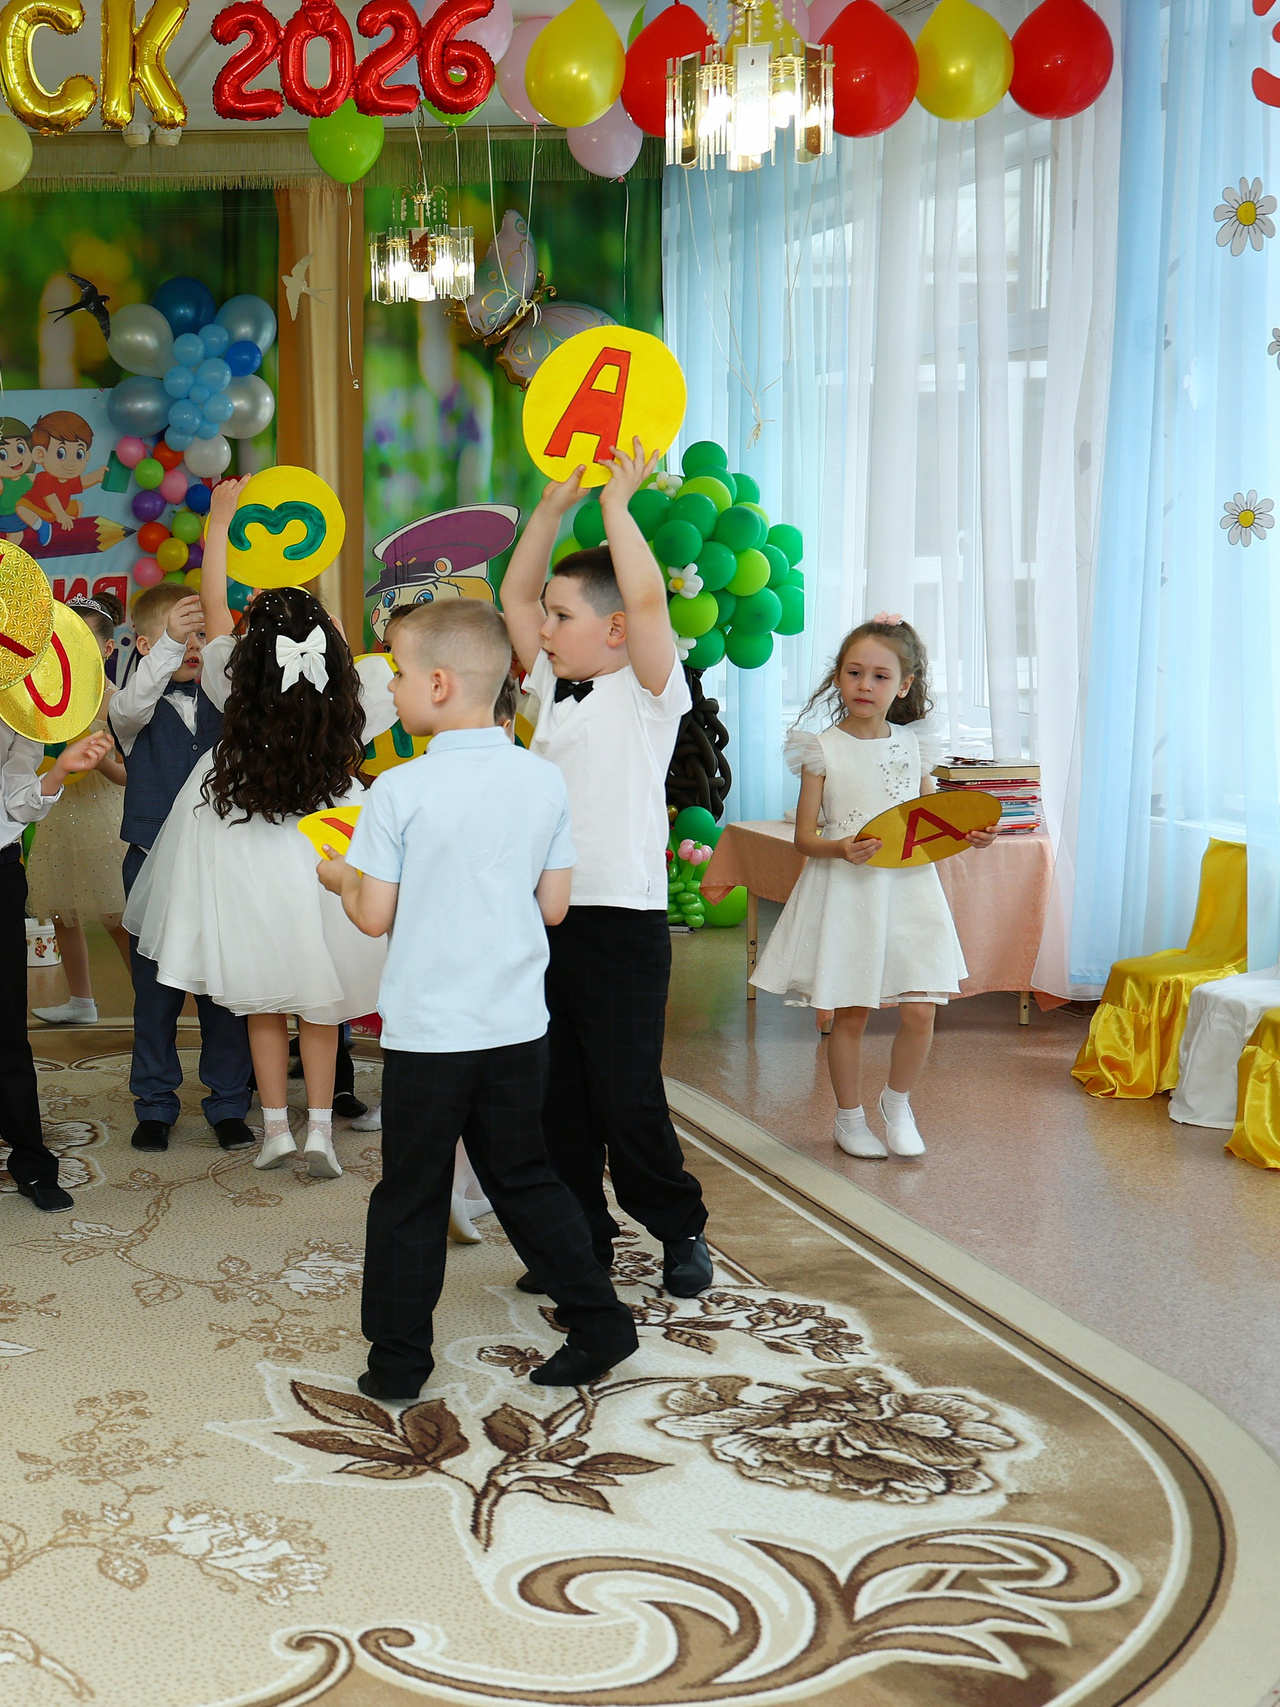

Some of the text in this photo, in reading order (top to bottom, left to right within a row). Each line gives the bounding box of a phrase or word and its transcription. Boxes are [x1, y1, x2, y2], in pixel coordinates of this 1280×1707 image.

[211, 0, 496, 120] 2026
[544, 346, 632, 465] А
[900, 806, 967, 862] А
